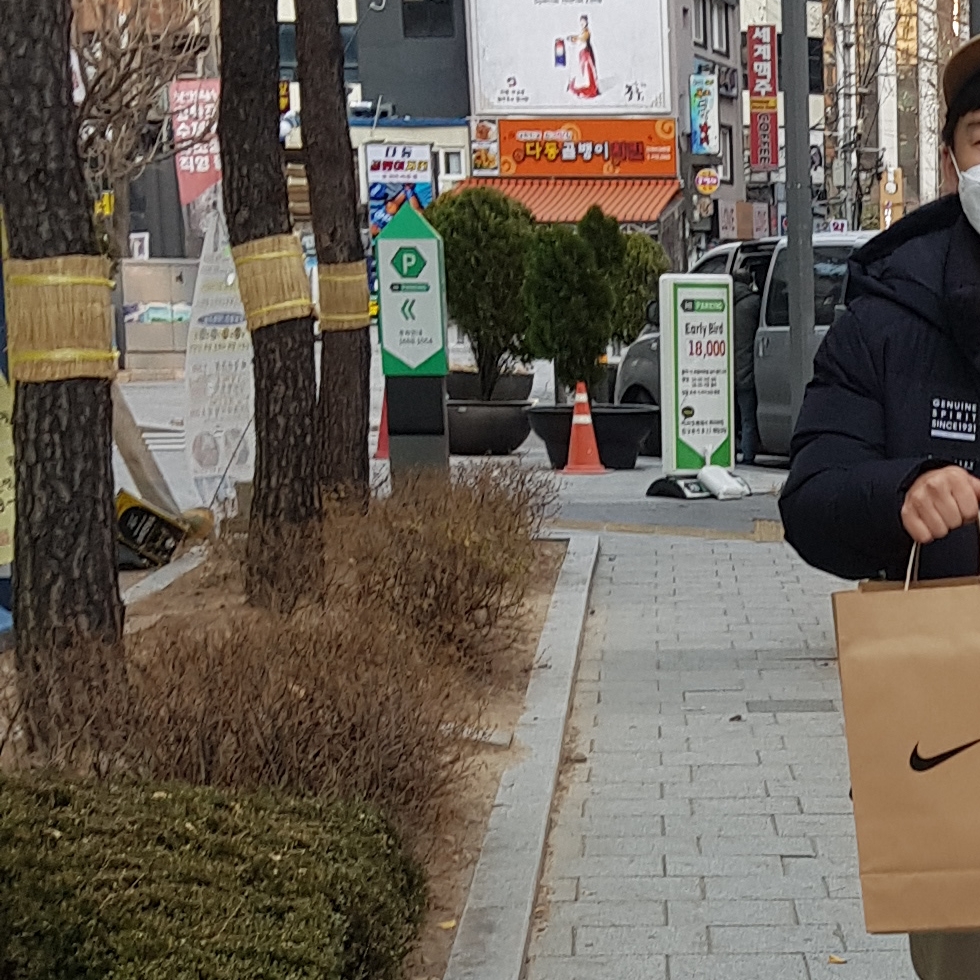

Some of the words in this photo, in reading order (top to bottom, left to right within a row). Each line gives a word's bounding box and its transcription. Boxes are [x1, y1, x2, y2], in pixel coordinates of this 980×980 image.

[752, 26, 773, 97] 세계맥주
[402, 253, 417, 275] P
[685, 322, 708, 338] Early
[709, 322, 724, 335] Bird
[688, 340, 726, 359] 18,000
[932, 397, 977, 413] GENUINE
[931, 408, 977, 423] SPIRIT
